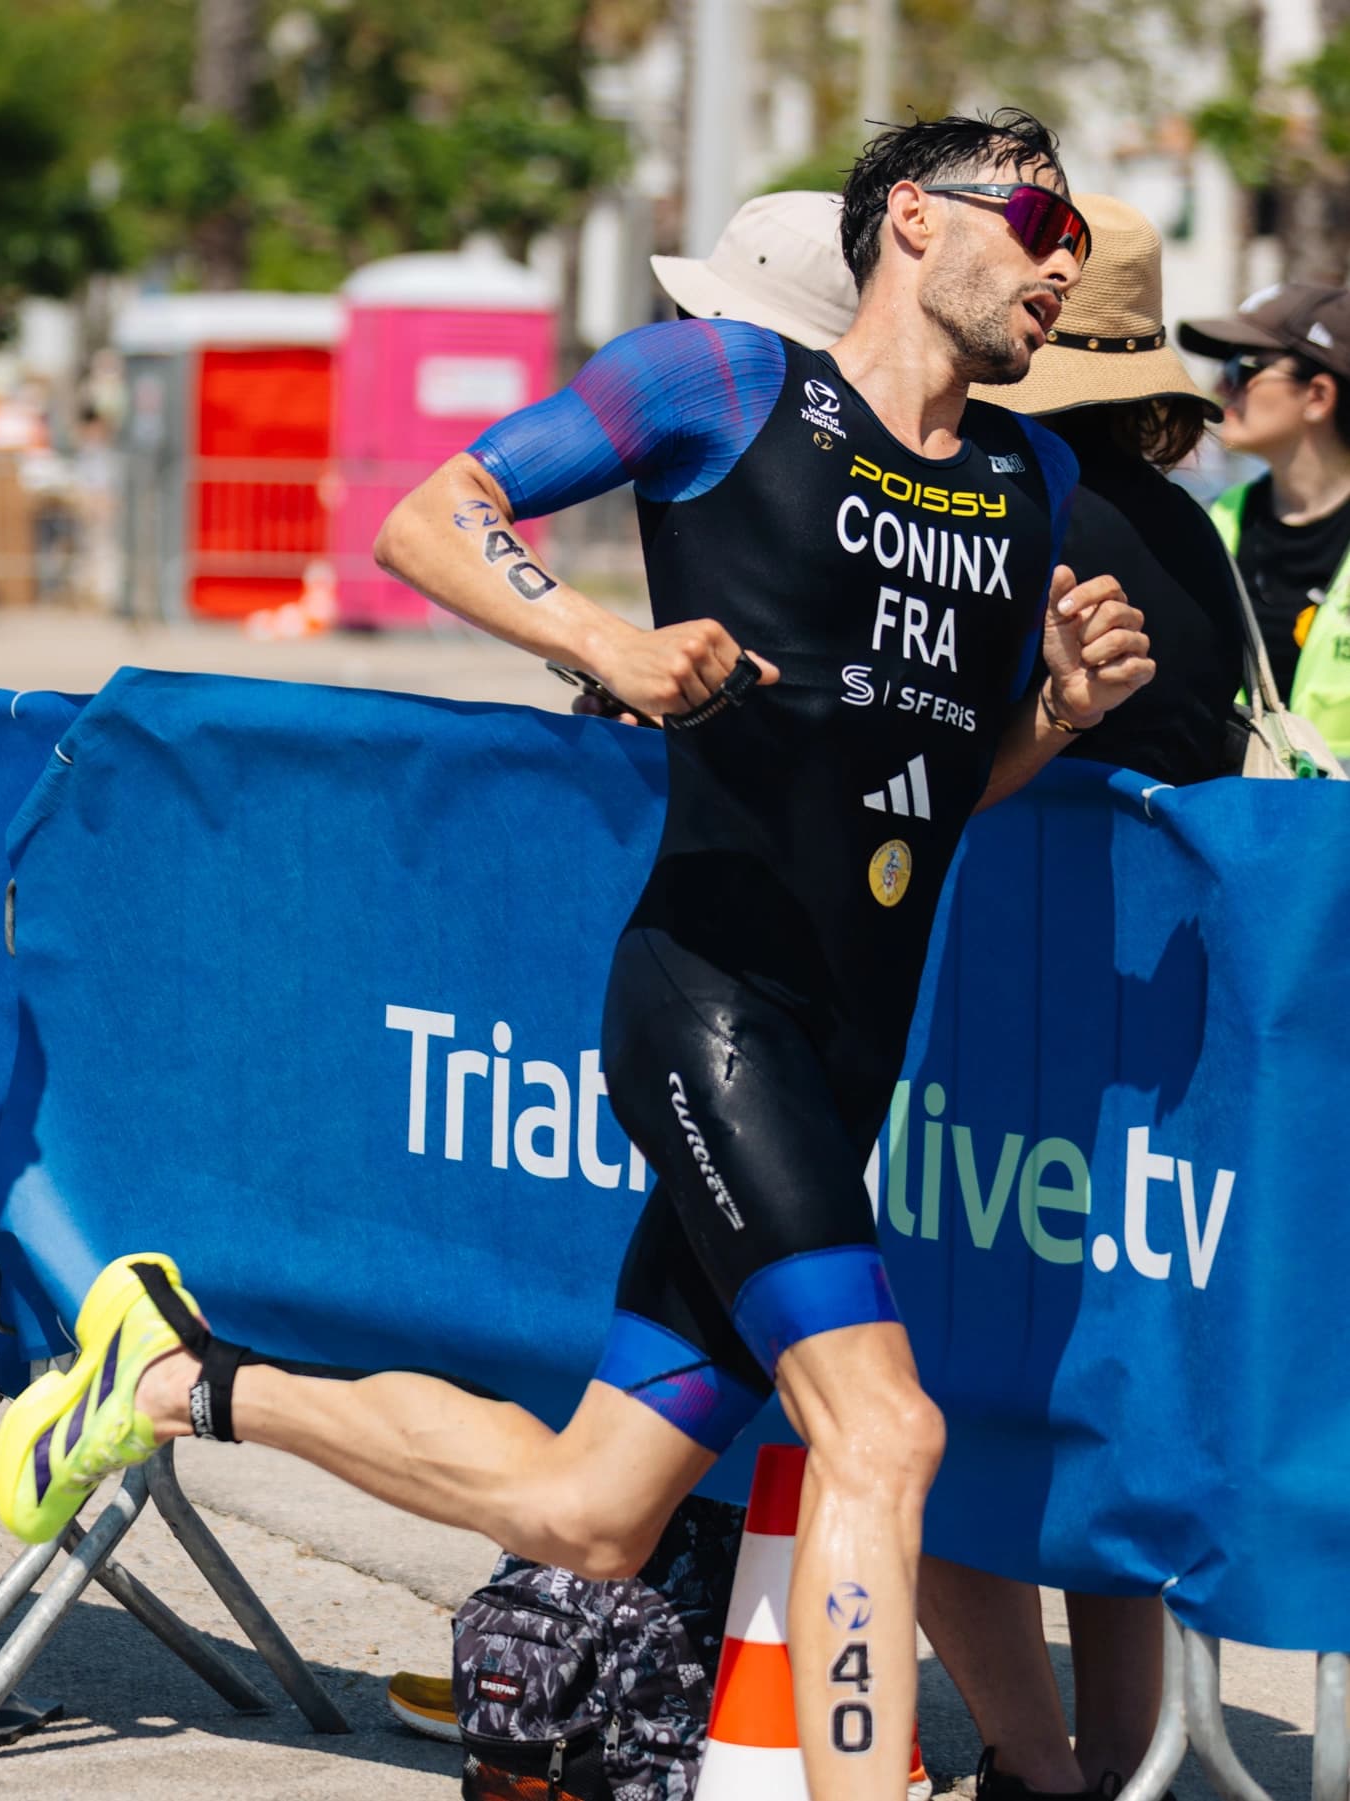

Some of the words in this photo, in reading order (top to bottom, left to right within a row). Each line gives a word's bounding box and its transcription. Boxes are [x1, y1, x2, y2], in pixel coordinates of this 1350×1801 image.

[800, 409, 847, 440] Triathlon
[807, 405, 839, 428] World
[850, 455, 1007, 518] POISSY
[485, 530, 557, 600] 40
[836, 495, 1012, 600] CONINX
[872, 586, 957, 673] FRA
[830, 1641, 873, 1752] 40
